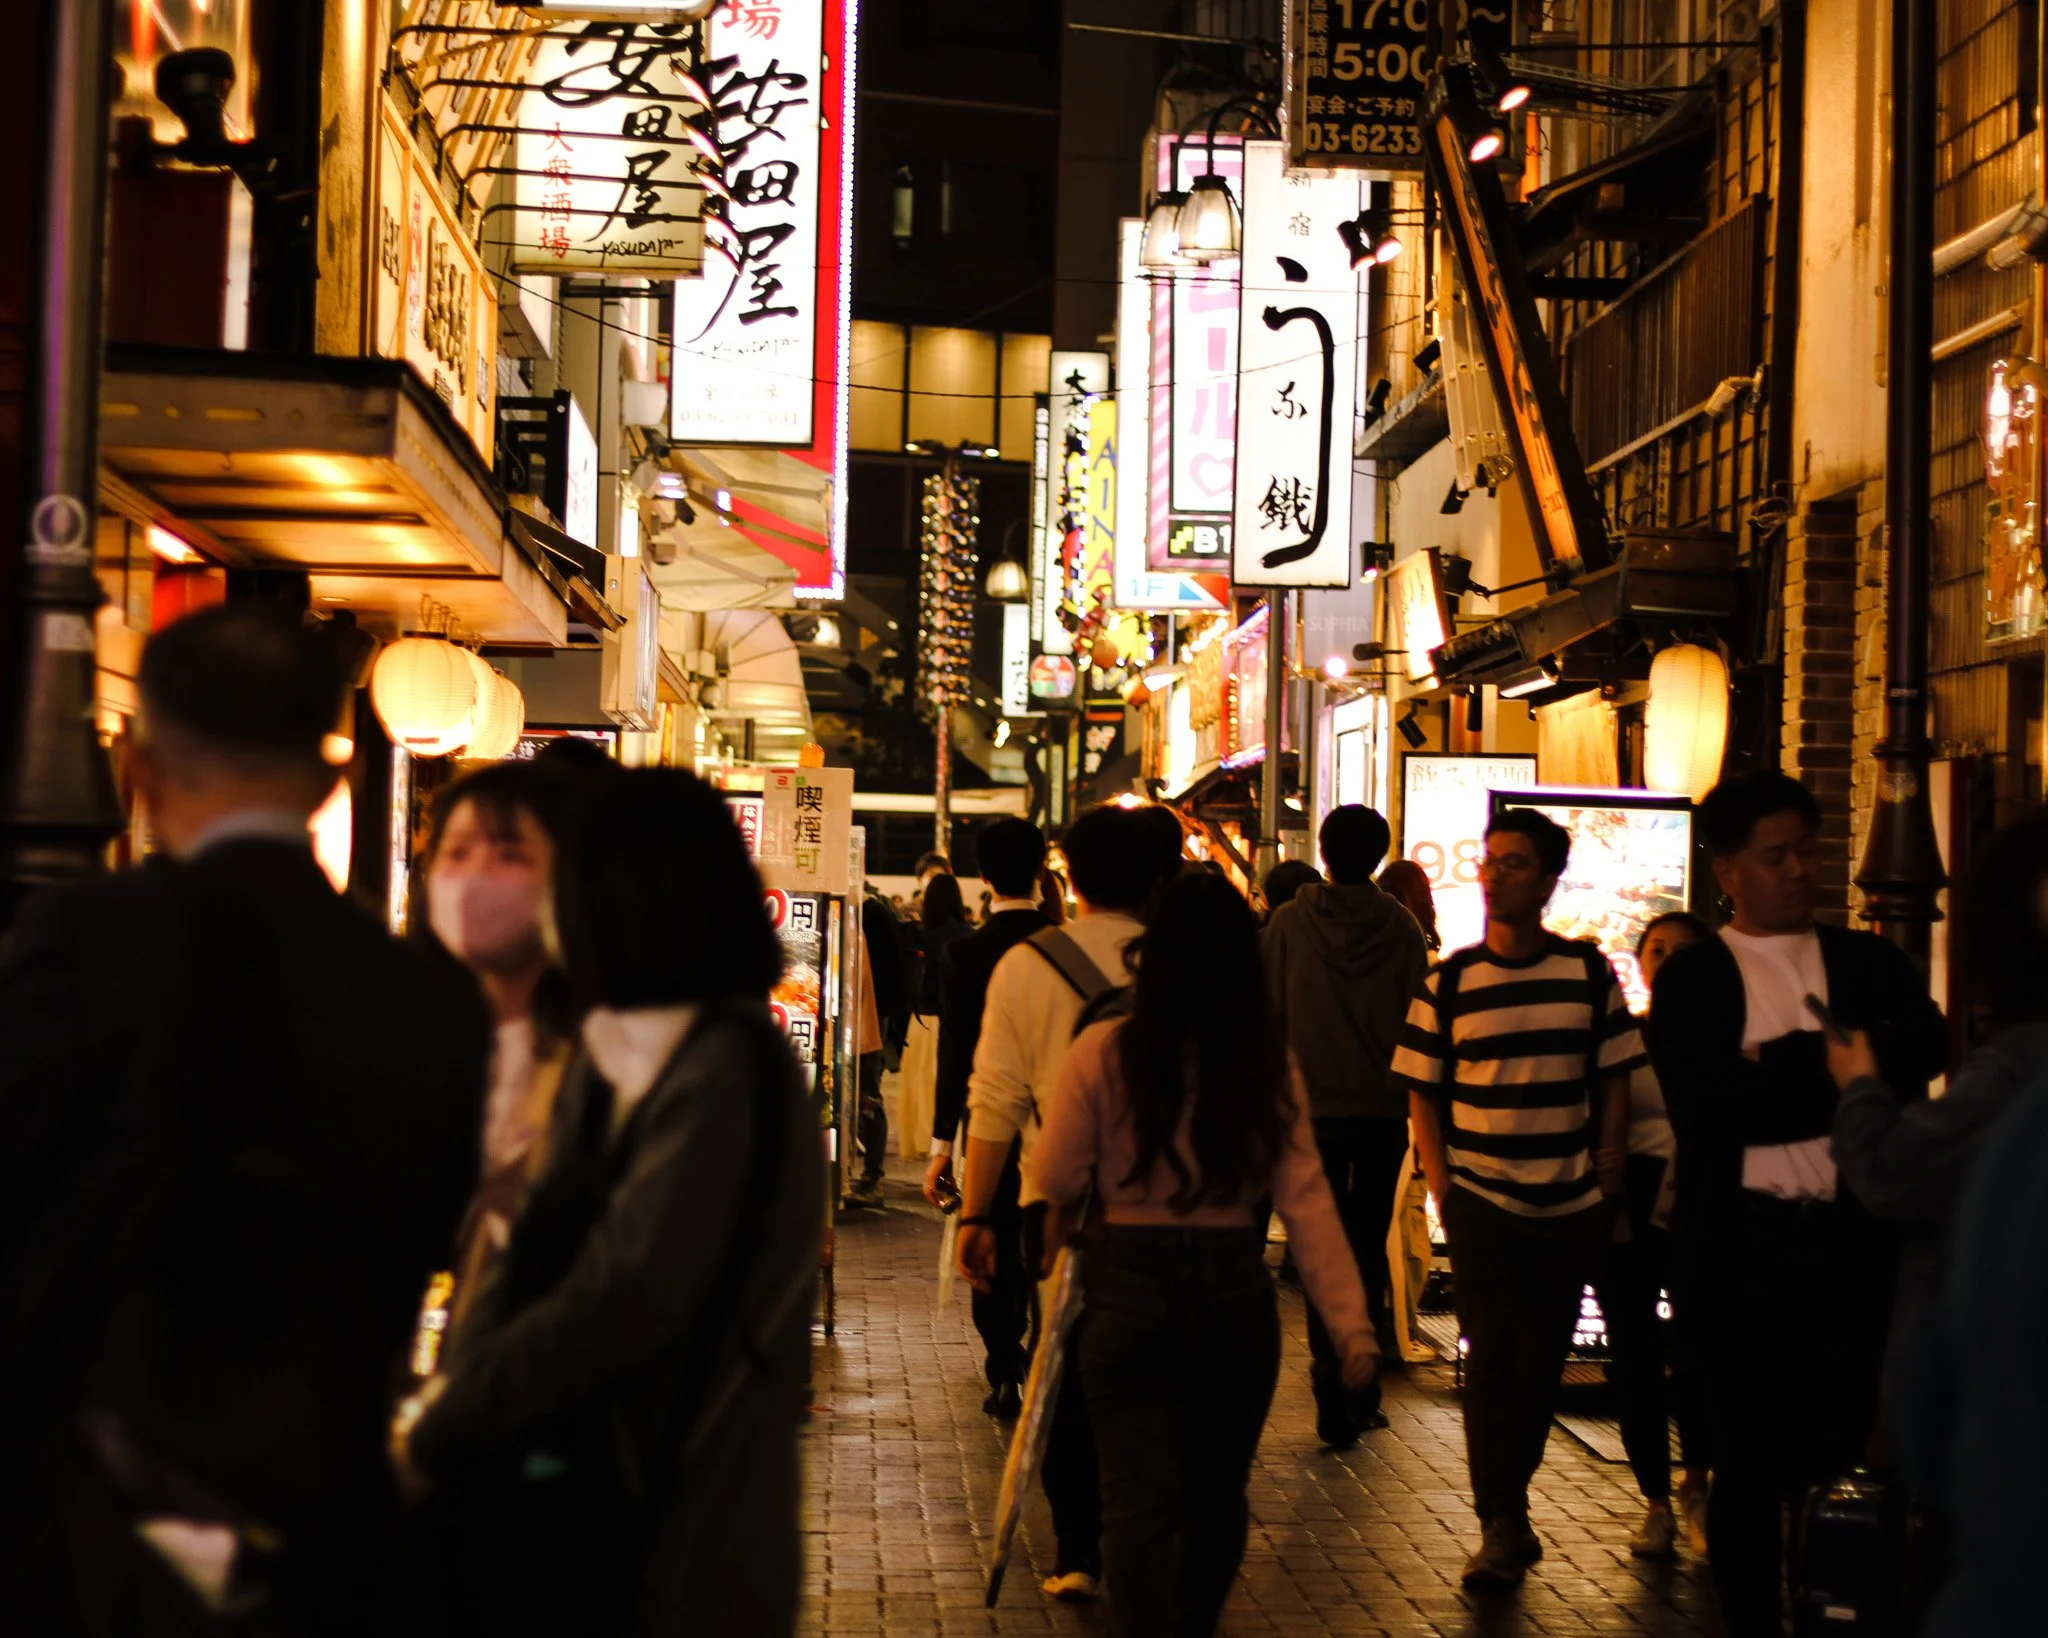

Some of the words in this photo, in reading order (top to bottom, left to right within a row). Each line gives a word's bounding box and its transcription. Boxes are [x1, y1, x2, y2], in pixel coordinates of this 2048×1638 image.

[539, 121, 574, 260] 大衆酒場
[1308, 615, 1369, 632] SOPHIA
[793, 785, 824, 874] 喫煙可
